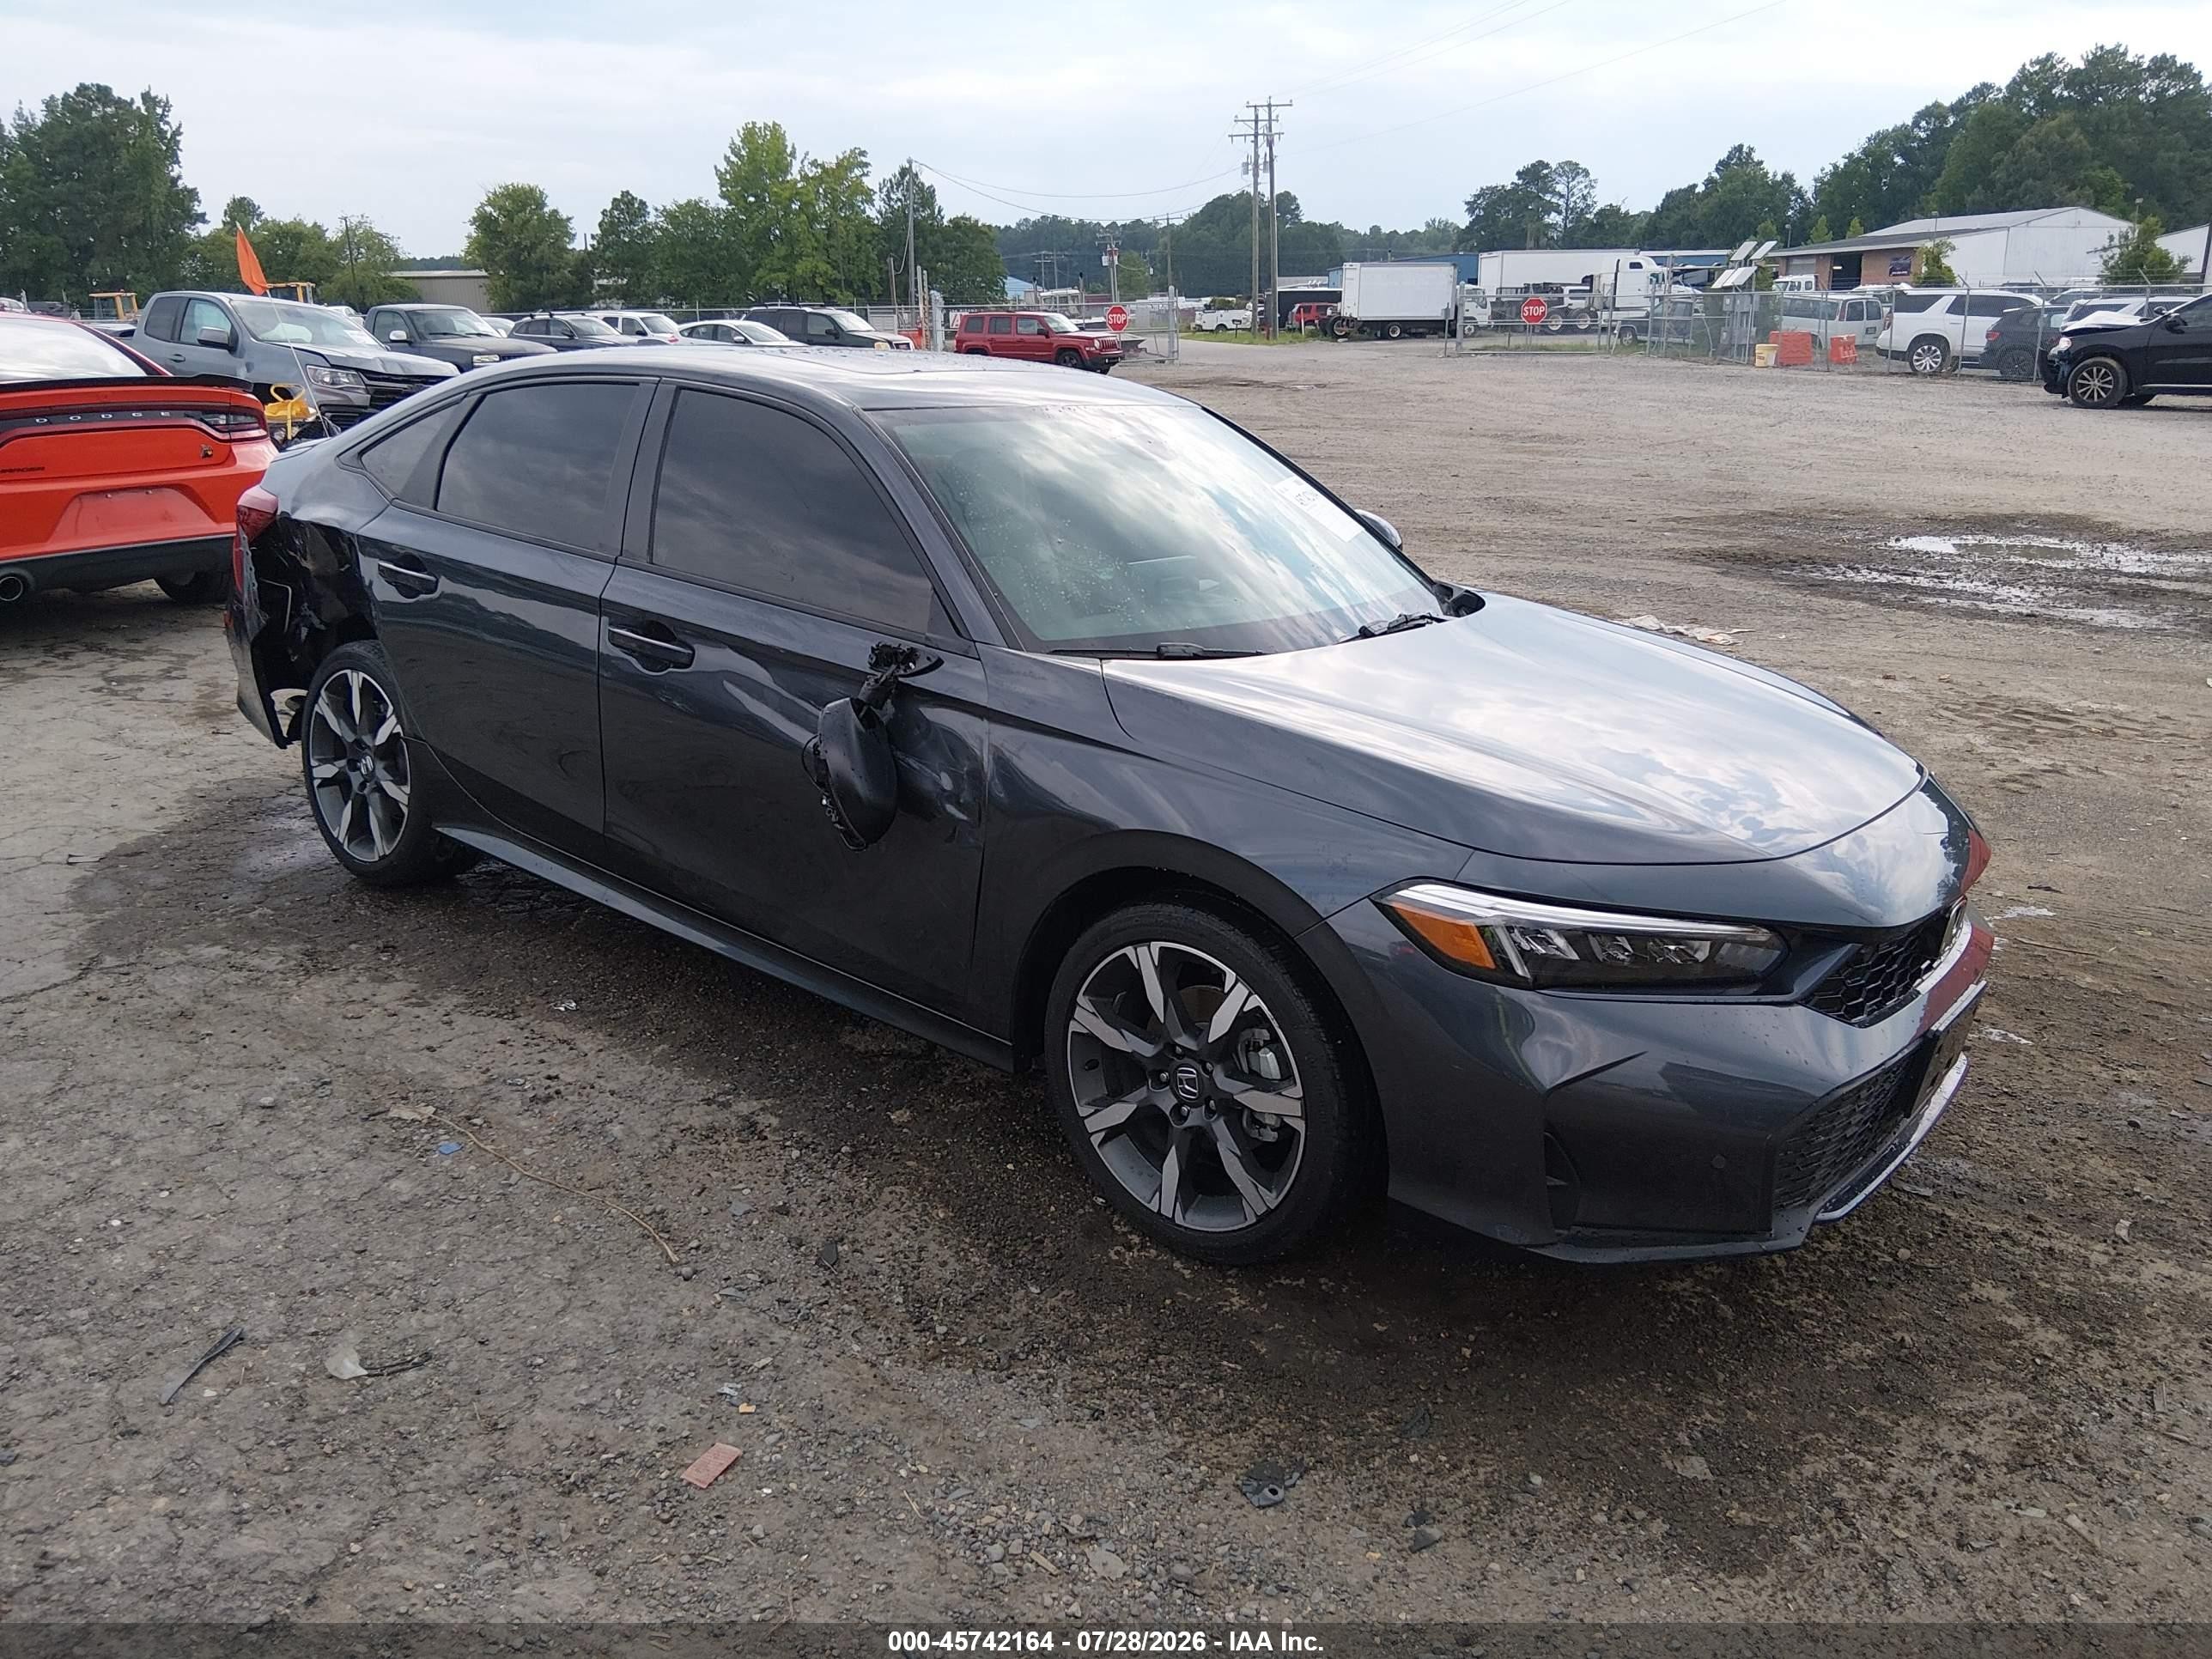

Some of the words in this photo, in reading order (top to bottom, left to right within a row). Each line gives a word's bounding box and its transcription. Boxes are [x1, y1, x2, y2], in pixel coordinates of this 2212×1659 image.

[1522, 306, 1546, 317] STOP
[1108, 313, 1126, 325] STOP
[35, 410, 171, 424] DODGE
